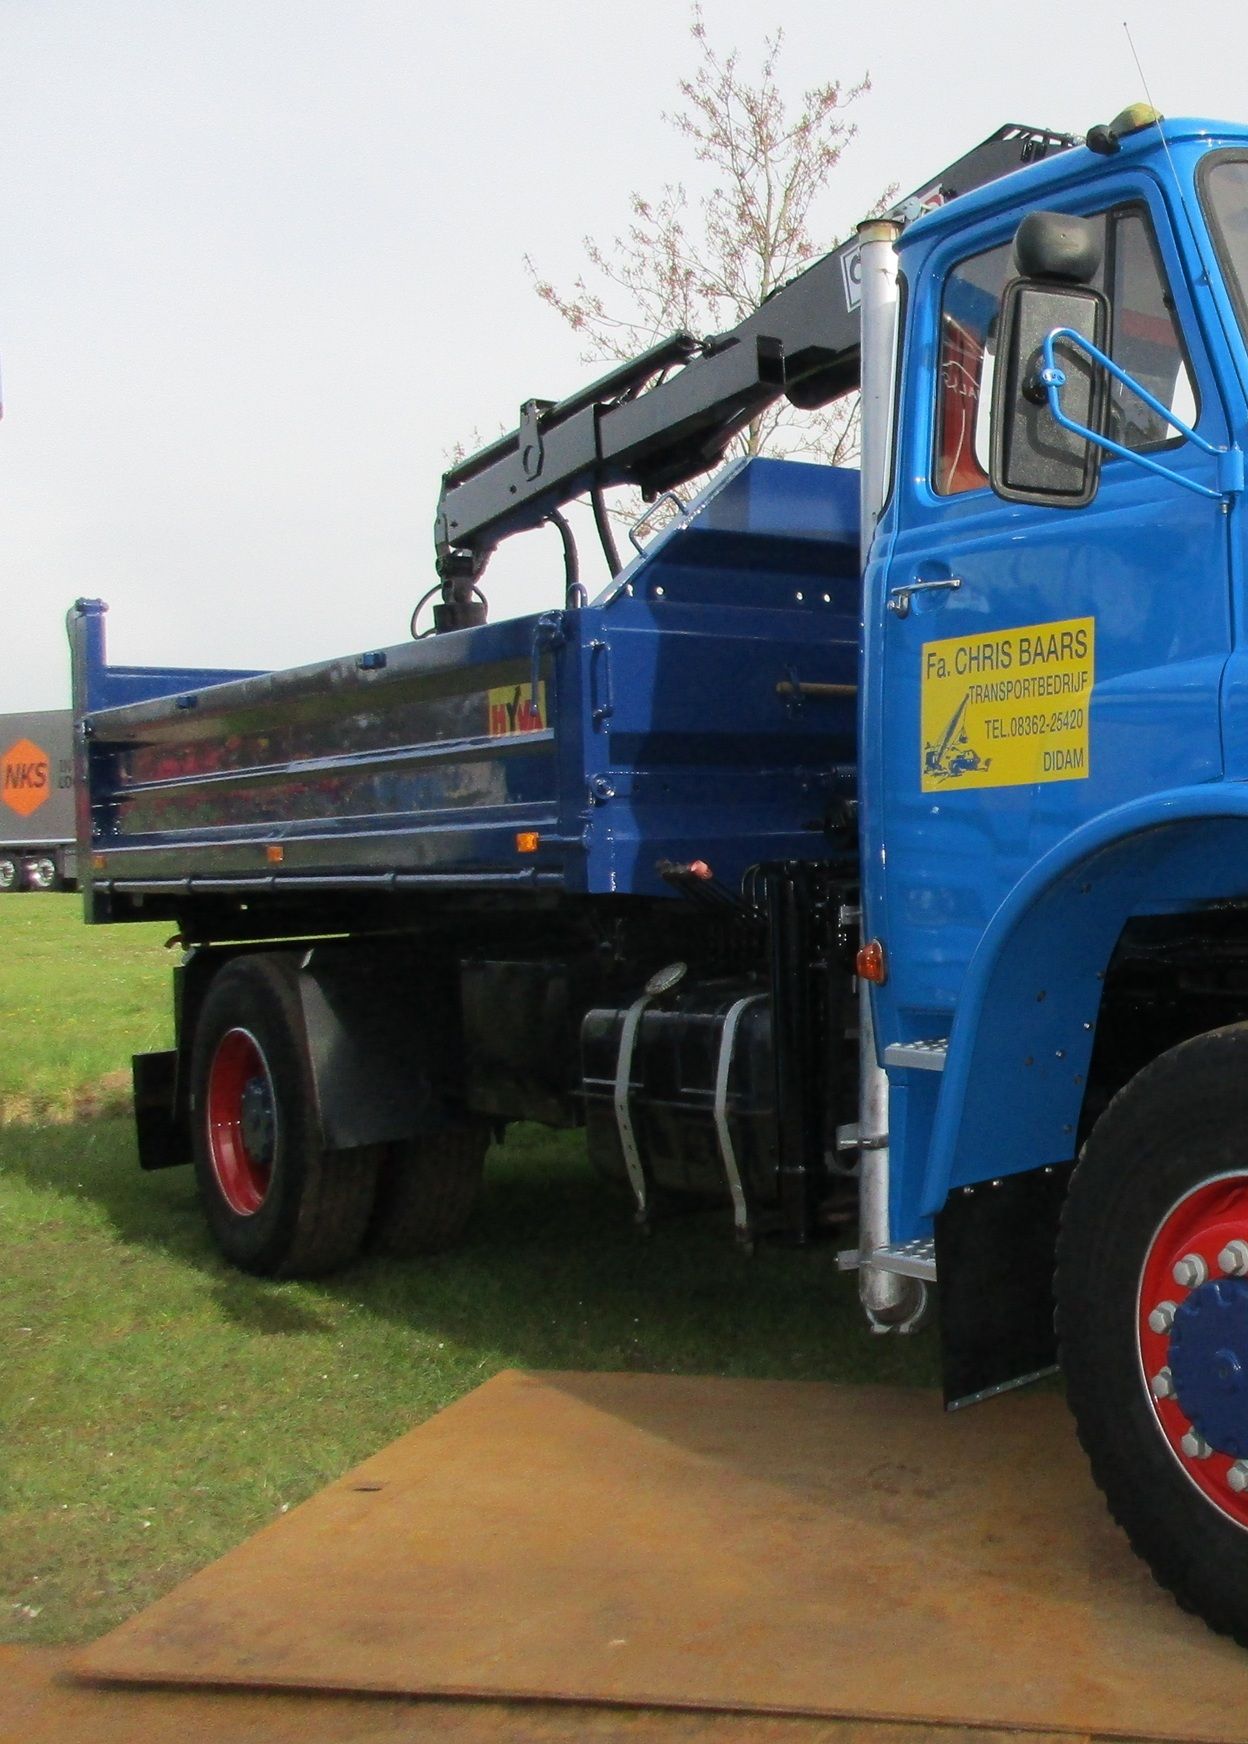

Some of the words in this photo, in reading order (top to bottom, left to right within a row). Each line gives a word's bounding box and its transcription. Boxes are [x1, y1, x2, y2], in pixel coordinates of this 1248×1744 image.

[927, 652, 950, 681] Fa.
[955, 640, 1012, 675] CHRIS
[1019, 629, 1088, 666] BAARS
[969, 671, 1088, 705] TRANSPORTBEDRIJF
[492, 686, 544, 735] HYVA
[5, 763, 47, 789] NKS
[1043, 748, 1084, 772] DIDAM
